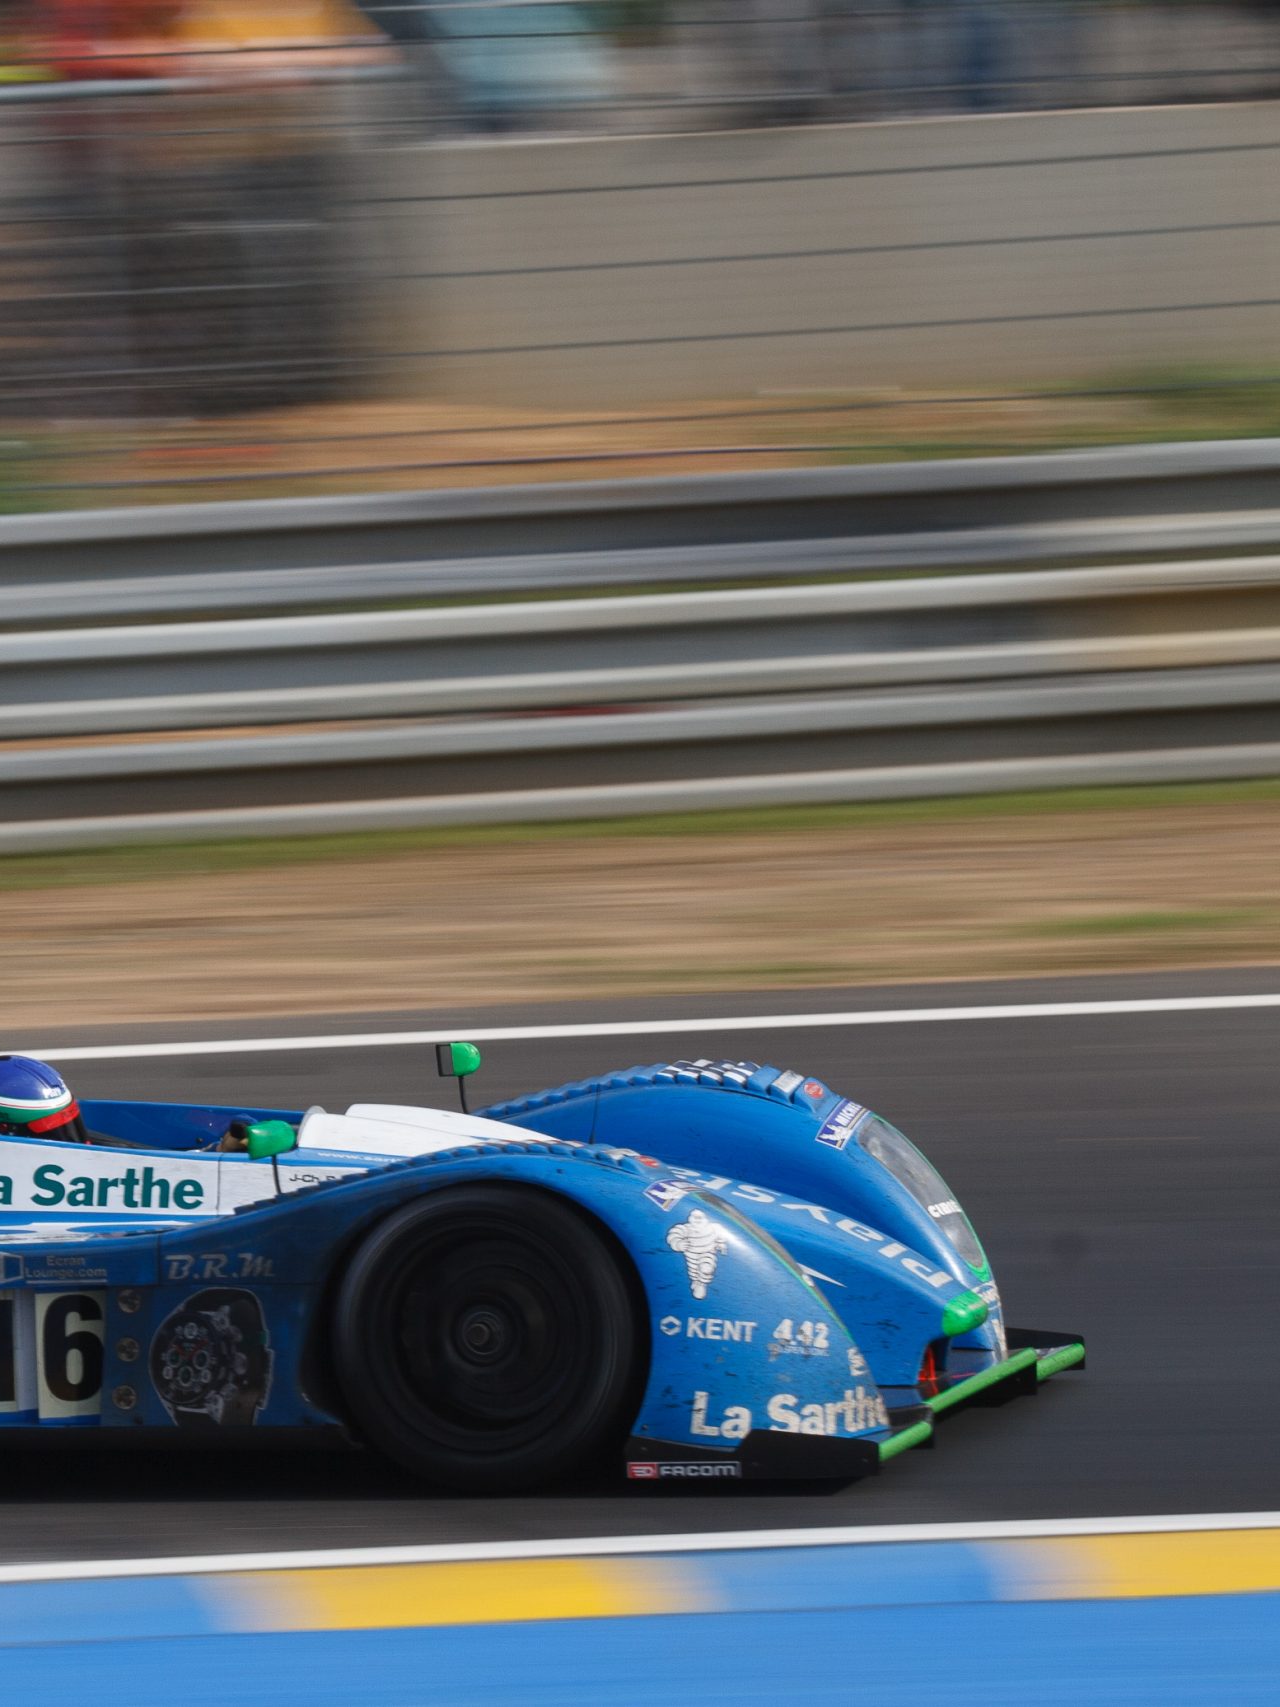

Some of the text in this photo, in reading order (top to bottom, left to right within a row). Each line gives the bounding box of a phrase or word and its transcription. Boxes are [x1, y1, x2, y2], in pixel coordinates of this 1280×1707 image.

[29, 1163, 203, 1209] Sarthe
[46, 1255, 86, 1266] Ecran
[25, 1266, 108, 1280] Lounge.com
[686, 1317, 758, 1342] KENT
[690, 1391, 752, 1440] La
[659, 1463, 737, 1477] FACOM
